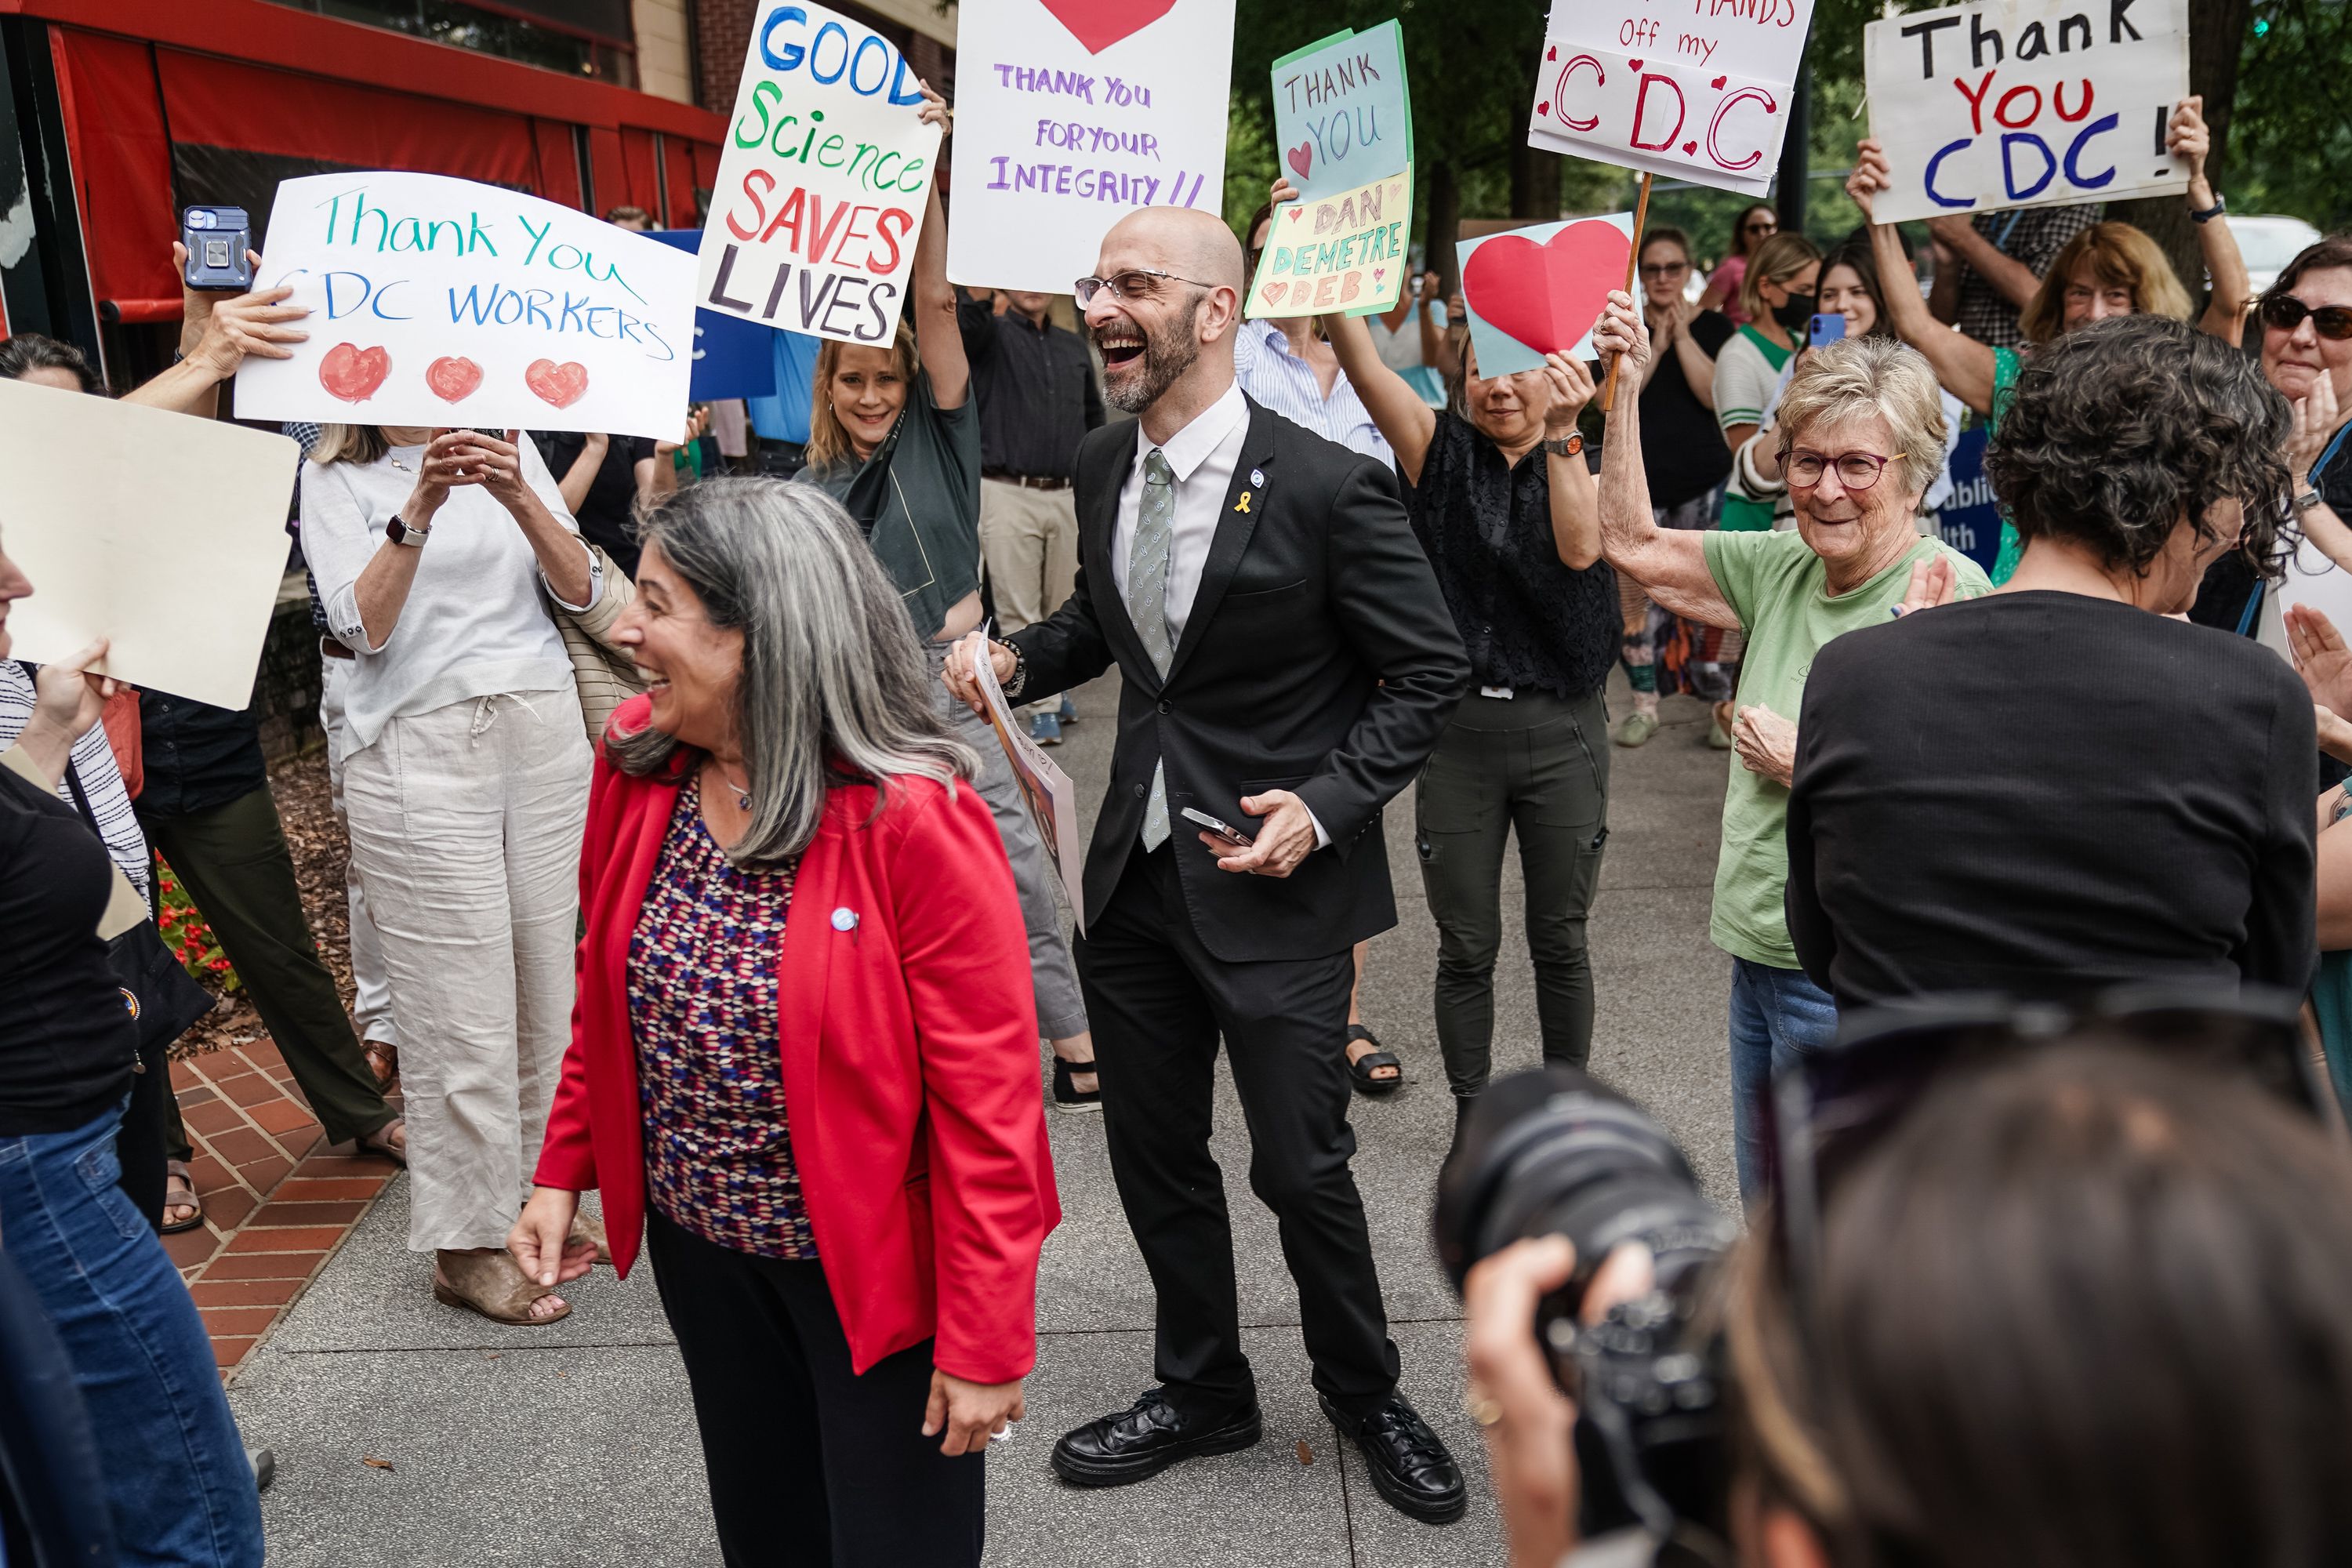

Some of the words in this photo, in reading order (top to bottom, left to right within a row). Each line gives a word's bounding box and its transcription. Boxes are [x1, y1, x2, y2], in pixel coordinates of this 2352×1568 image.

[1678, 34, 1718, 67] my
[1901, 0, 2143, 79] Thank
[993, 64, 1094, 105] THANK
[1103, 76, 1150, 108] YOU
[1284, 53, 1381, 113] THANK
[1955, 70, 2094, 134] YOU
[735, 81, 924, 193] Science
[1305, 105, 1382, 165] YOU
[1925, 113, 2119, 207] CDC
[986, 156, 1160, 205] INTEGRITY
[1314, 184, 1383, 235] DAN
[315, 186, 499, 258] Thank
[518, 215, 648, 305] You
[726, 169, 913, 275] SAVES
[1272, 221, 1402, 276] DEMETRE
[708, 244, 896, 341] LIVES
[1290, 271, 1363, 308] DEB
[449, 283, 674, 361] WORKERS
[1944, 476, 1999, 511] ublic
[1943, 522, 1976, 551] lth
